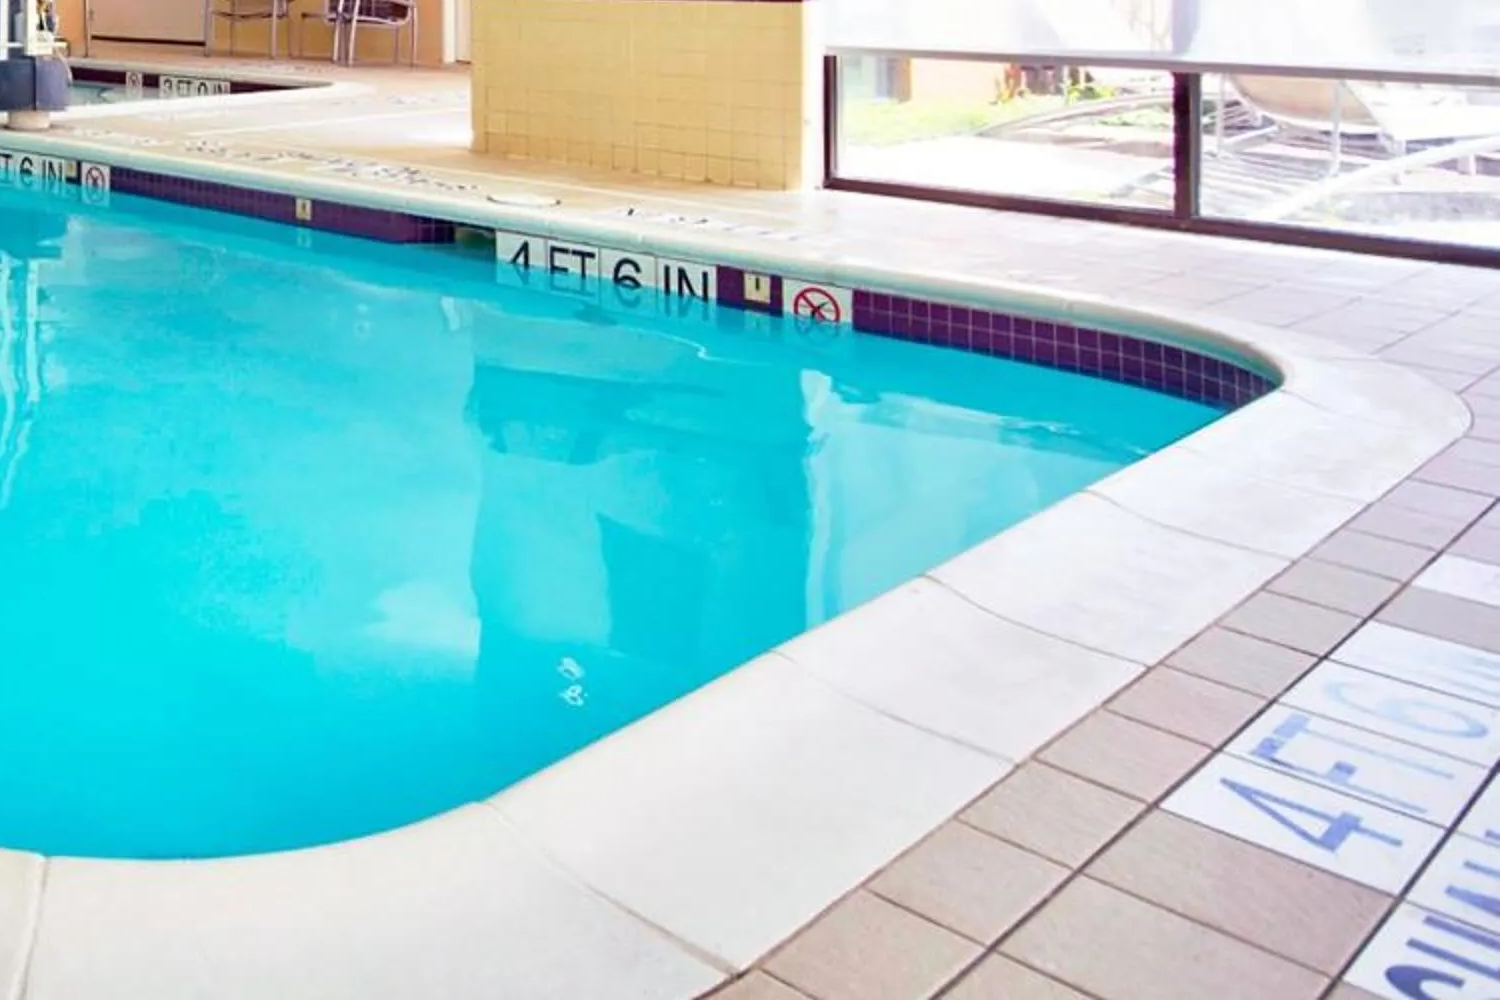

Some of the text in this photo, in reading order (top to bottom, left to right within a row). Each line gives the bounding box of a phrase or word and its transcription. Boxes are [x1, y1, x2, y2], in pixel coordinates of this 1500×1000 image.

[43, 159, 62, 182] IN
[510, 241, 709, 301] 4 FT 6 IN
[1249, 712, 1455, 814] FT
[1218, 776, 1403, 852] 4
